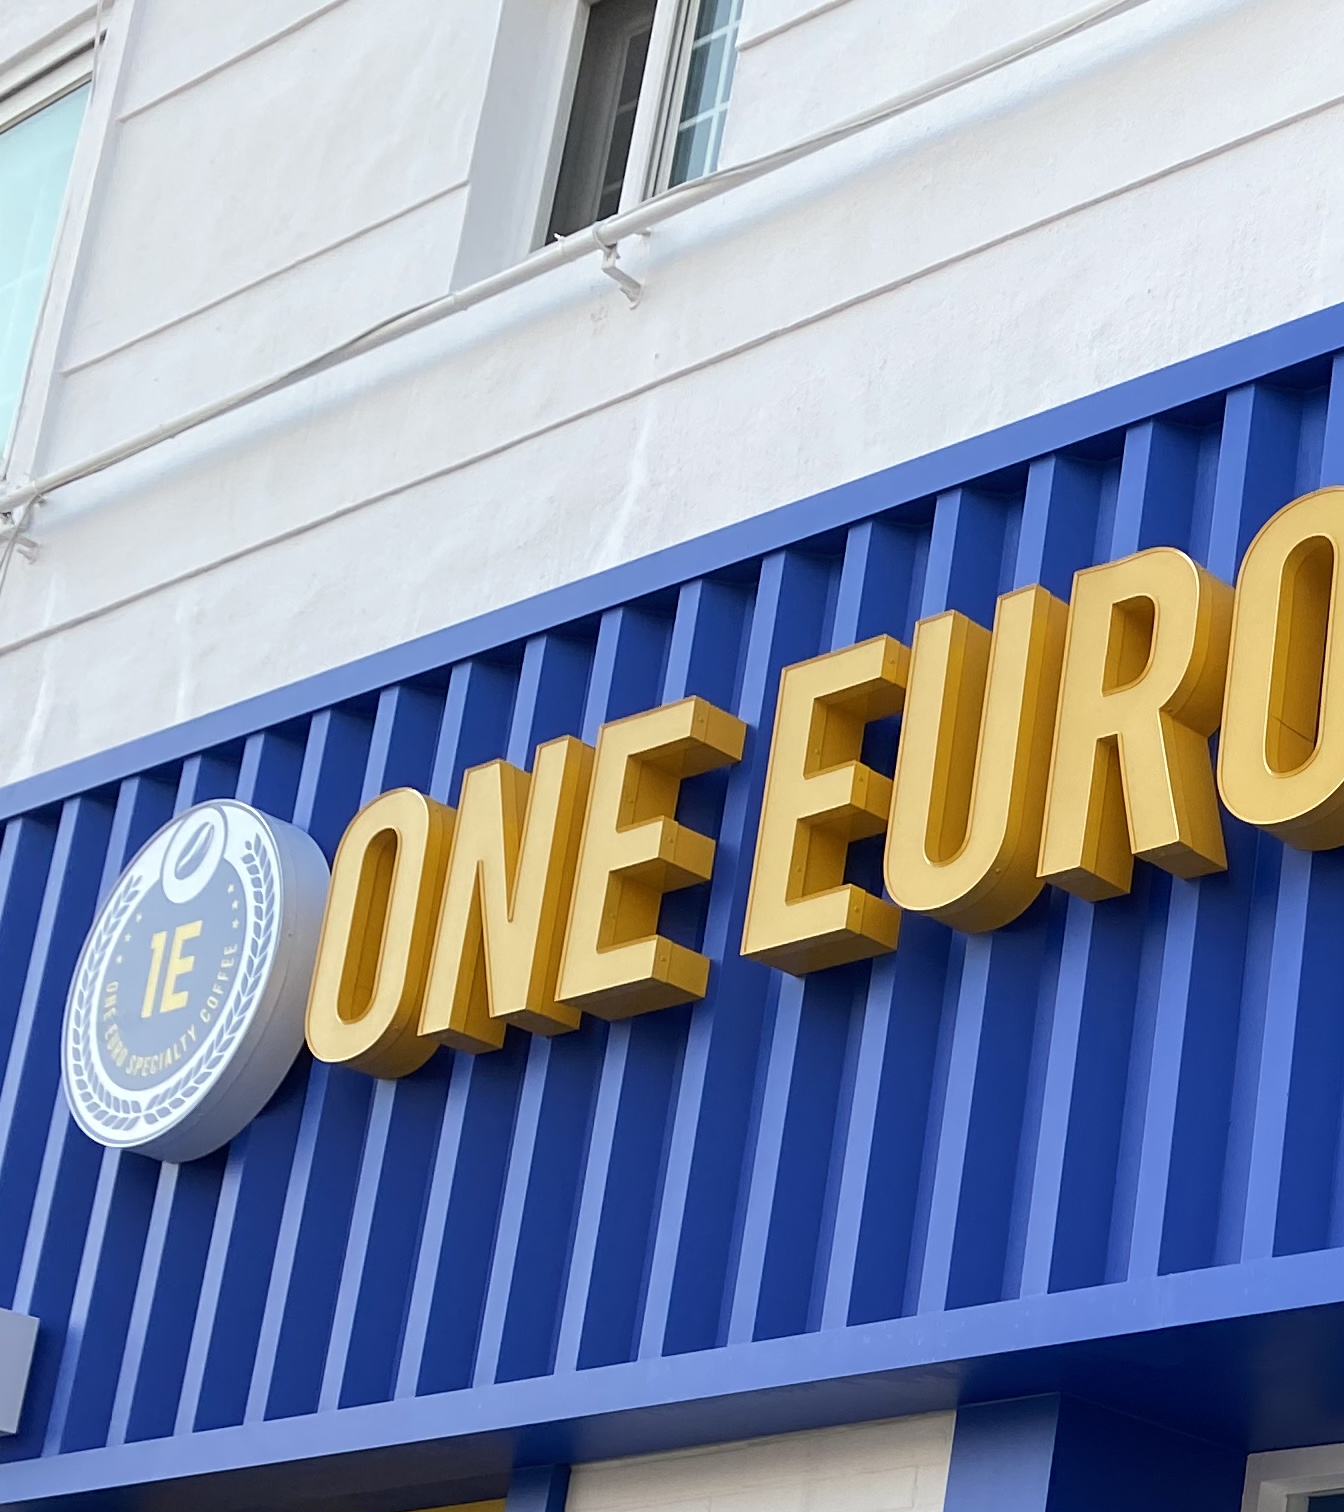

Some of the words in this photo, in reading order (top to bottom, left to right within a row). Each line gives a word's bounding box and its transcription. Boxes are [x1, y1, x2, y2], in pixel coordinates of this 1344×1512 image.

[304, 695, 747, 1079] ONE
[126, 1025, 196, 1076] SPECIALTY
[200, 944, 237, 1023] COFFEE
[140, 919, 204, 1020] 1E
